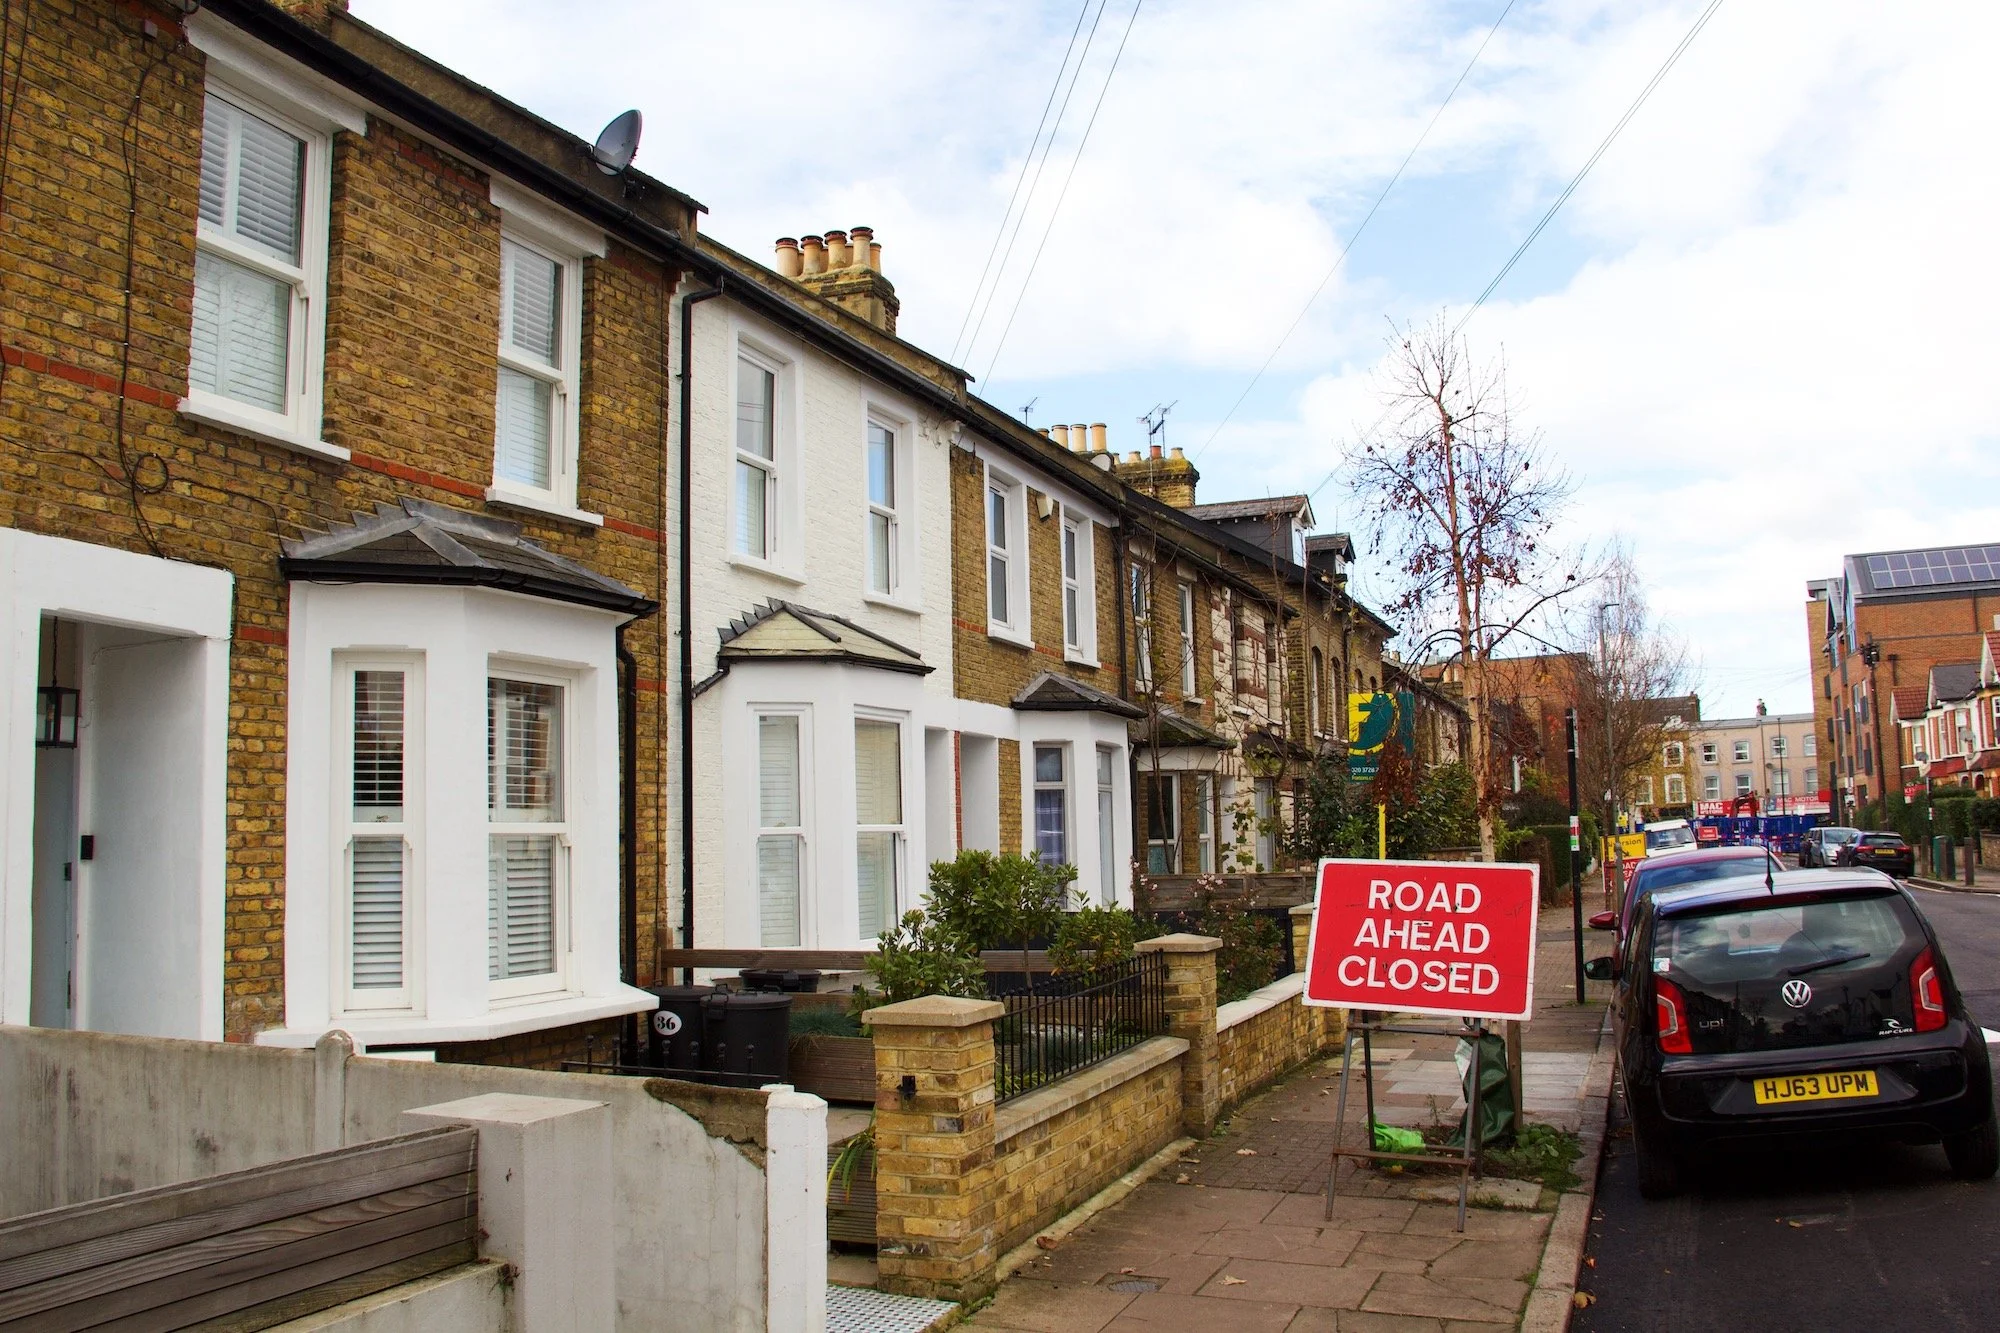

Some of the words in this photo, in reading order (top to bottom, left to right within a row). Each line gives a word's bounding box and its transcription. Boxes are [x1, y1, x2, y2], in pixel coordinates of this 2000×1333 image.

[1699, 802, 1723, 810] MAC
[1368, 880, 1482, 914] ROAD
[1354, 918, 1490, 954] AHEAD
[1338, 955, 1500, 995] CLOSED
[658, 1017, 675, 1030] 36
[1699, 1018, 1724, 1029] up!
[1764, 1078, 1820, 1100] HJ63
[1826, 1074, 1869, 1094] UPM
